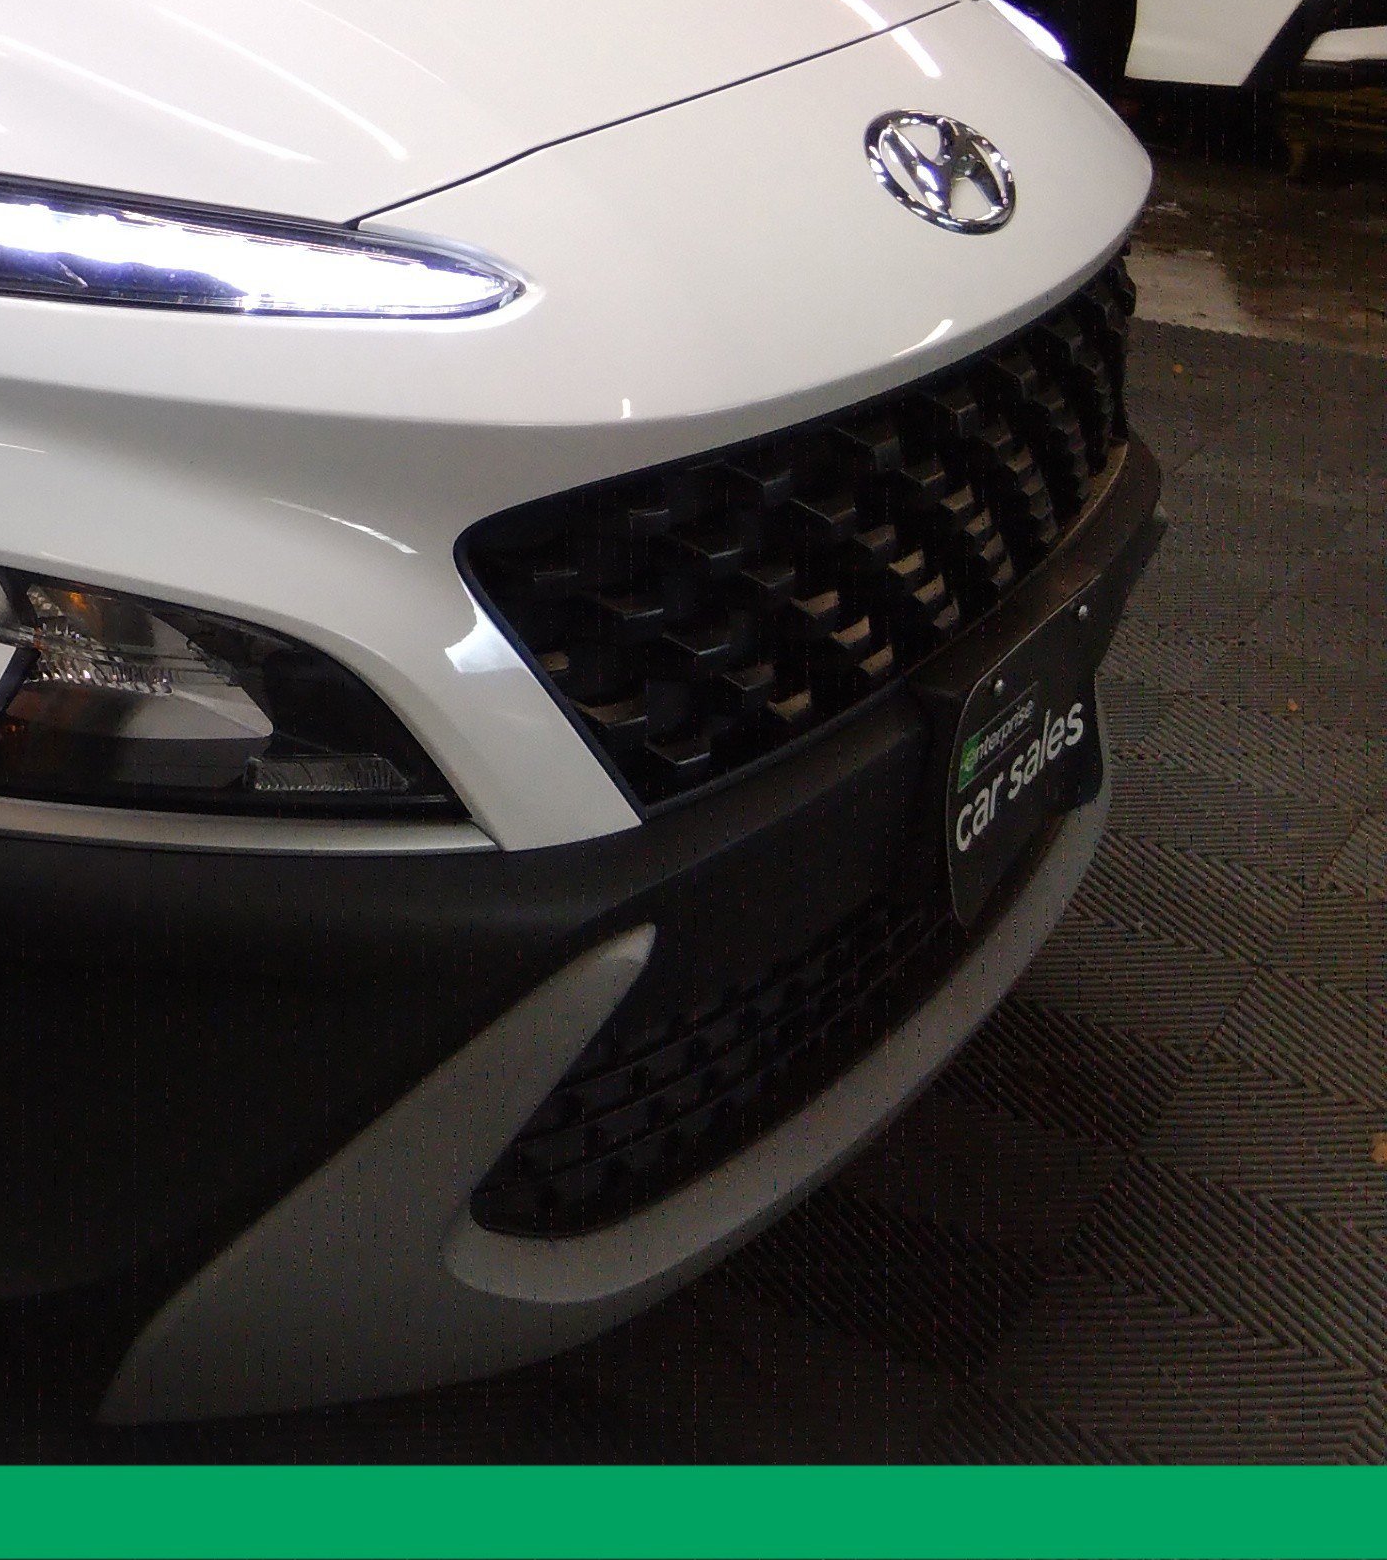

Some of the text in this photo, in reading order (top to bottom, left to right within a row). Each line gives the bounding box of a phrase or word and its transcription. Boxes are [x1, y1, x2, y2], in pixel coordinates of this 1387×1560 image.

[956, 703, 1083, 851] car sales
[961, 700, 1033, 771] enterprise
